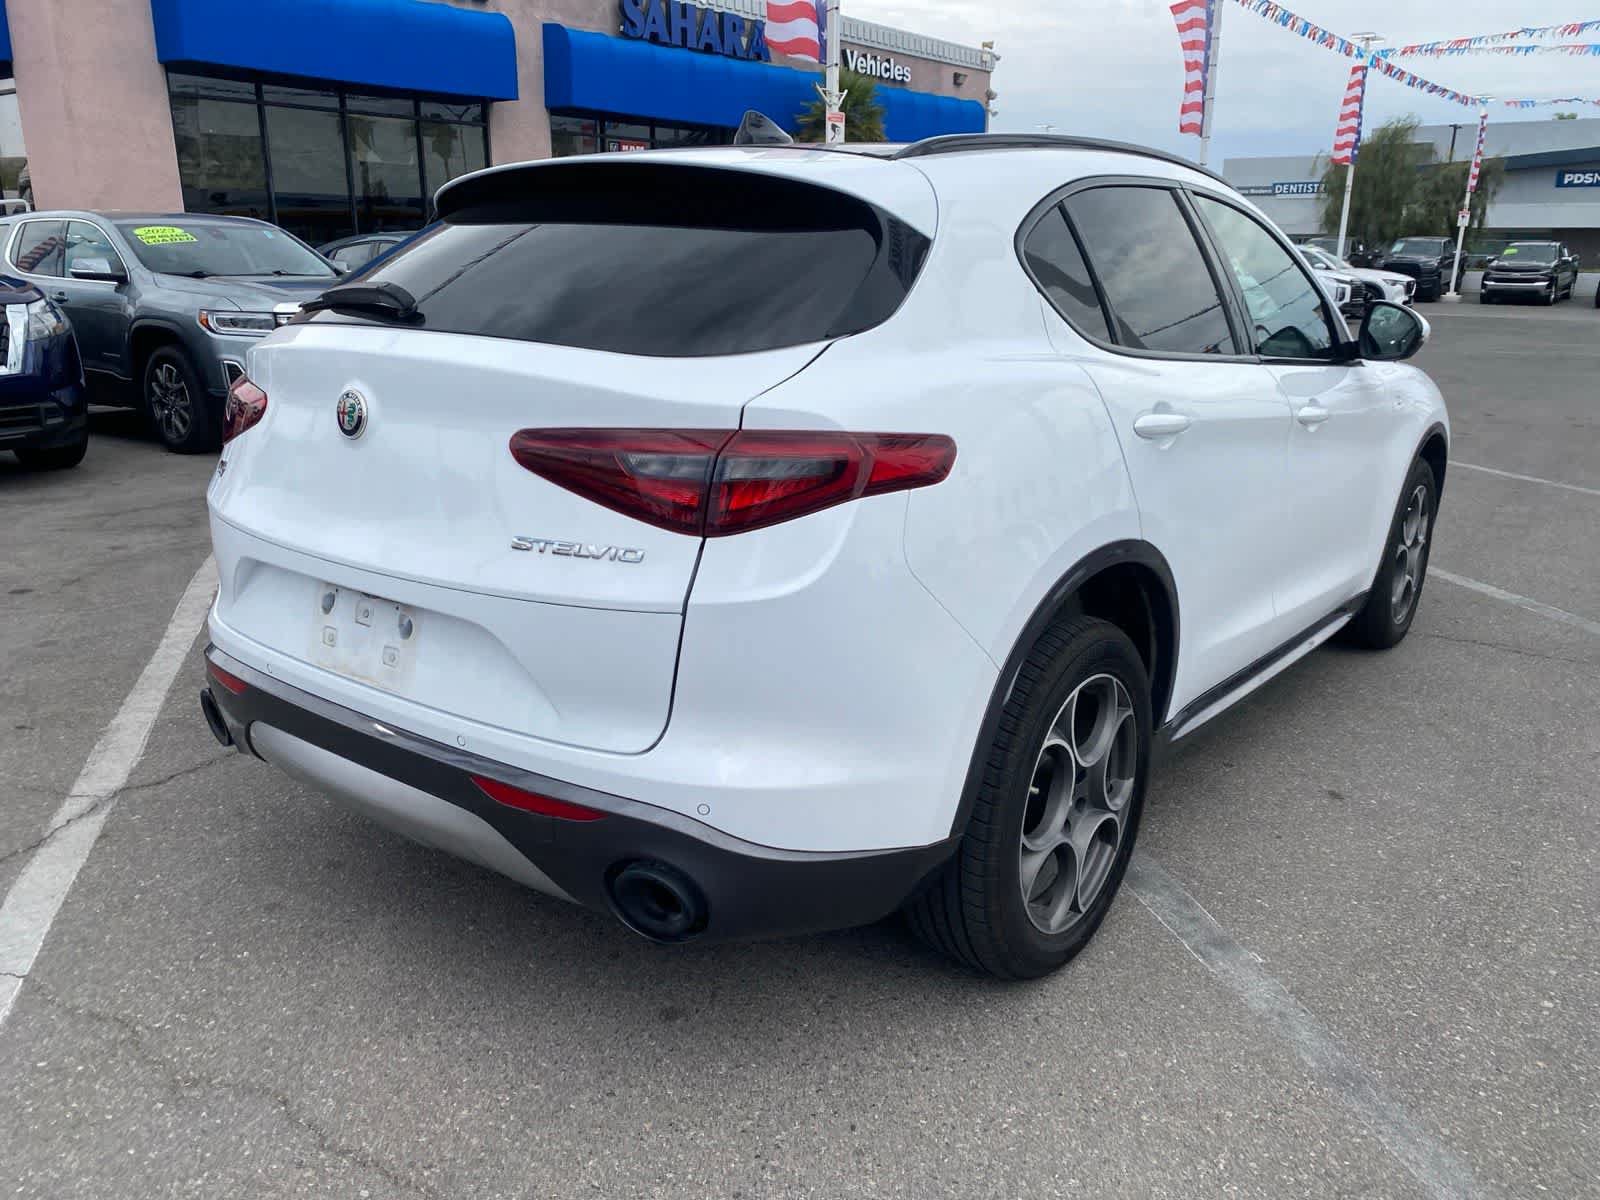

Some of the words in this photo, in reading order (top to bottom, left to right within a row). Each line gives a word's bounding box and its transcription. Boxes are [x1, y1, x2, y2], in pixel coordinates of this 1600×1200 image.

[621, 0, 771, 62] SAHARA
[844, 48, 912, 83] Vehicles
[511, 535, 645, 563] STELVIO
